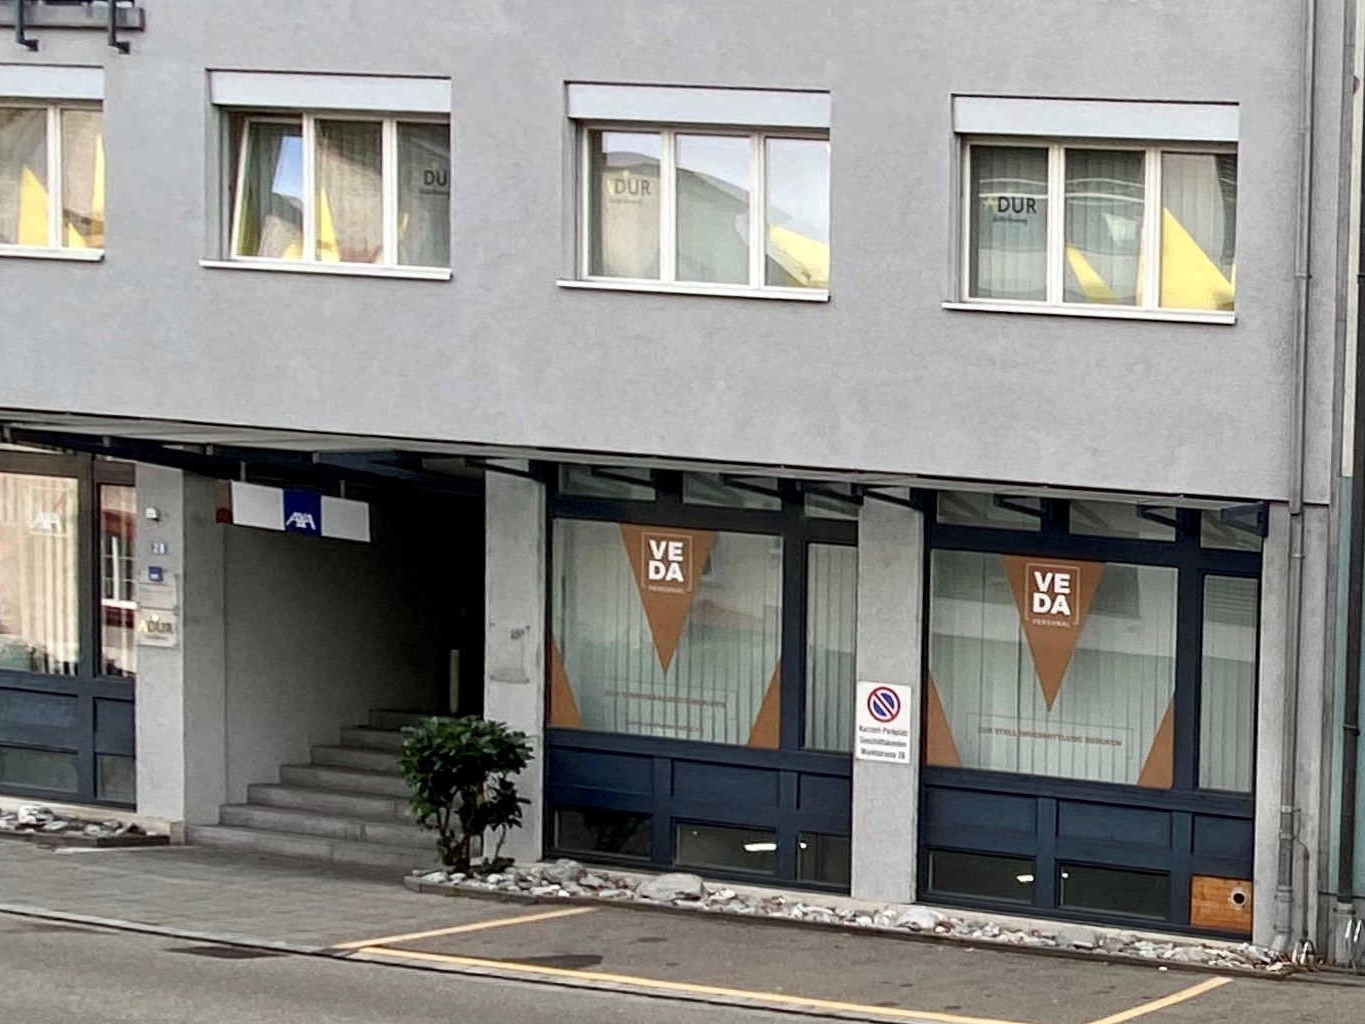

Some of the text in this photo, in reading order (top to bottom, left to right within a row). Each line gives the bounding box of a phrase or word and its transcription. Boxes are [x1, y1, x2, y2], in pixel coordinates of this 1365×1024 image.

[424, 169, 448, 186] DU
[614, 177, 651, 195] DUR
[997, 196, 1037, 214] DUR
[286, 511, 316, 530] AXA
